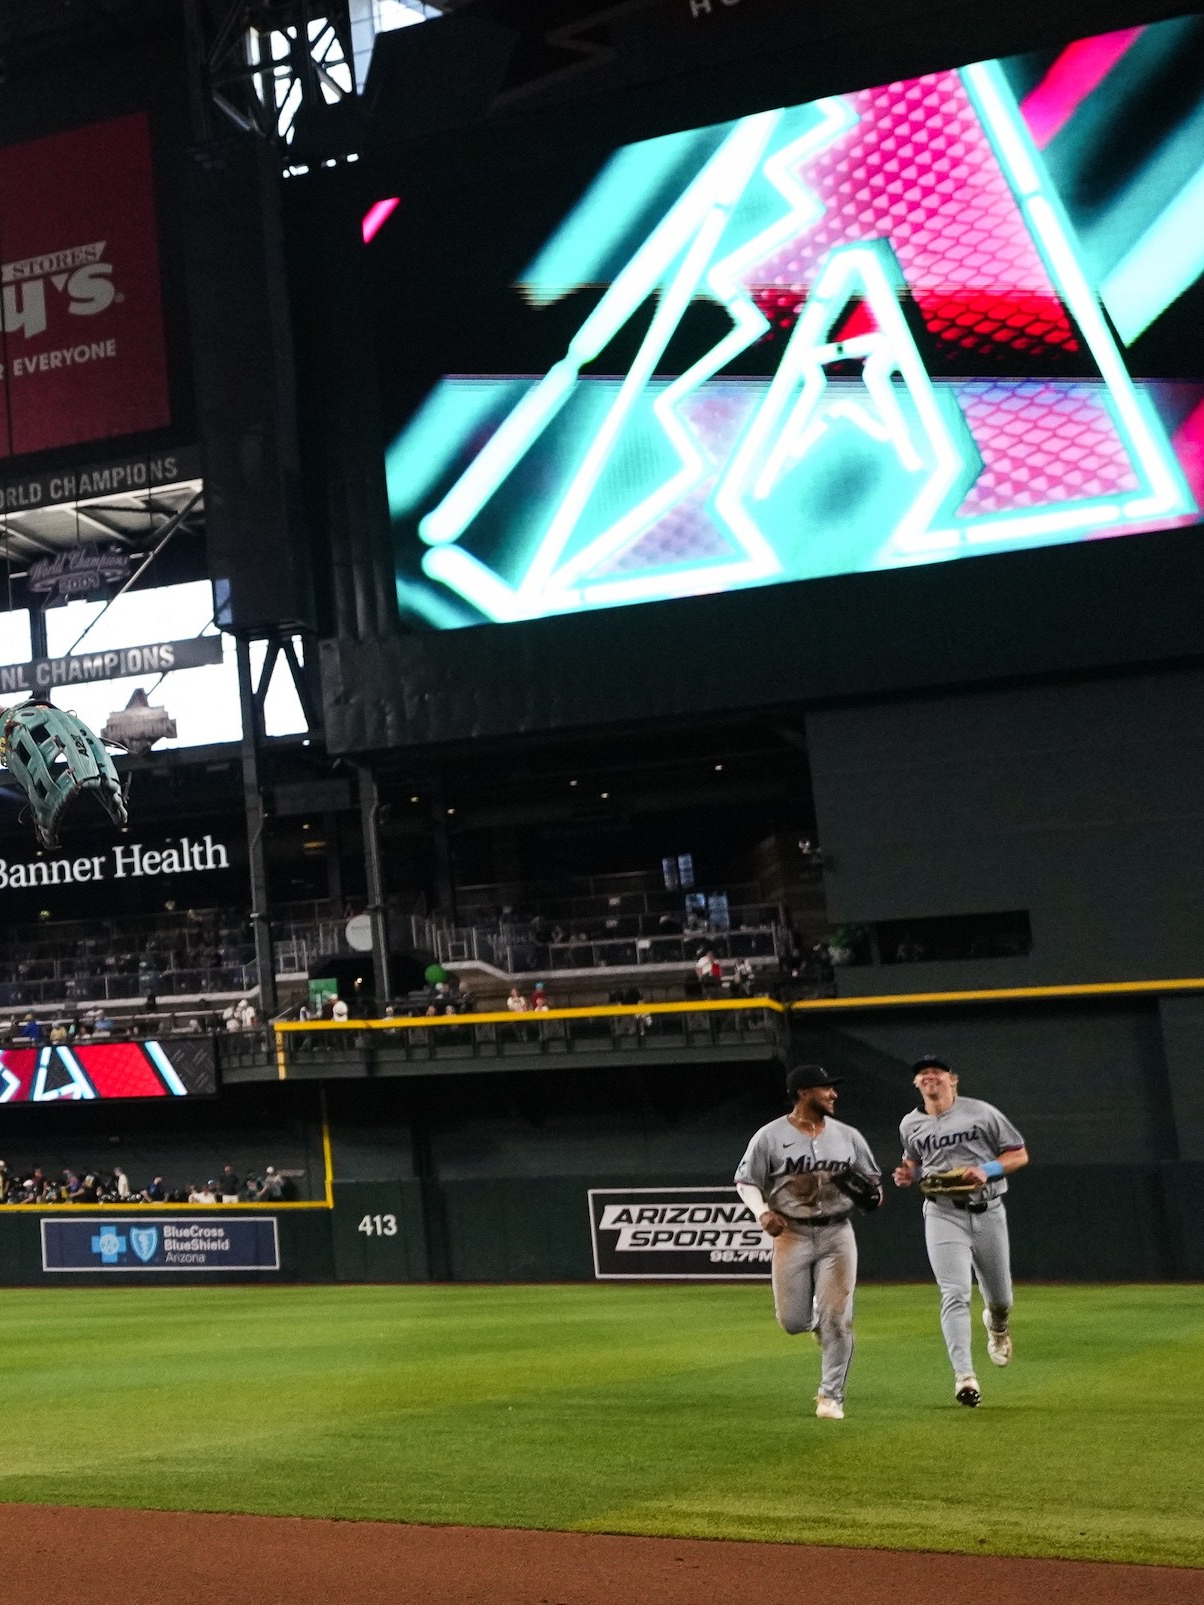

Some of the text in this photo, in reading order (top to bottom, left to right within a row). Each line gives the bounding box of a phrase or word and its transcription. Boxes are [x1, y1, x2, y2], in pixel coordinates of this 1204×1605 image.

[12, 246, 98, 279] STORES
[12, 338, 117, 377] EVERYONE
[49, 456, 179, 501] CHAMPIONS
[0, 643, 177, 691] NL CHAMPIONS
[112, 834, 230, 879] Health
[917, 1125, 978, 1152] Miami
[358, 1215, 398, 1236] 413
[611, 1207, 756, 1224] ARIZONA
[163, 1225, 225, 1238] BlueCross
[629, 1230, 763, 1247] SPORTS
[164, 1239, 230, 1251] BlueShield
[165, 1251, 205, 1263] Arizona
